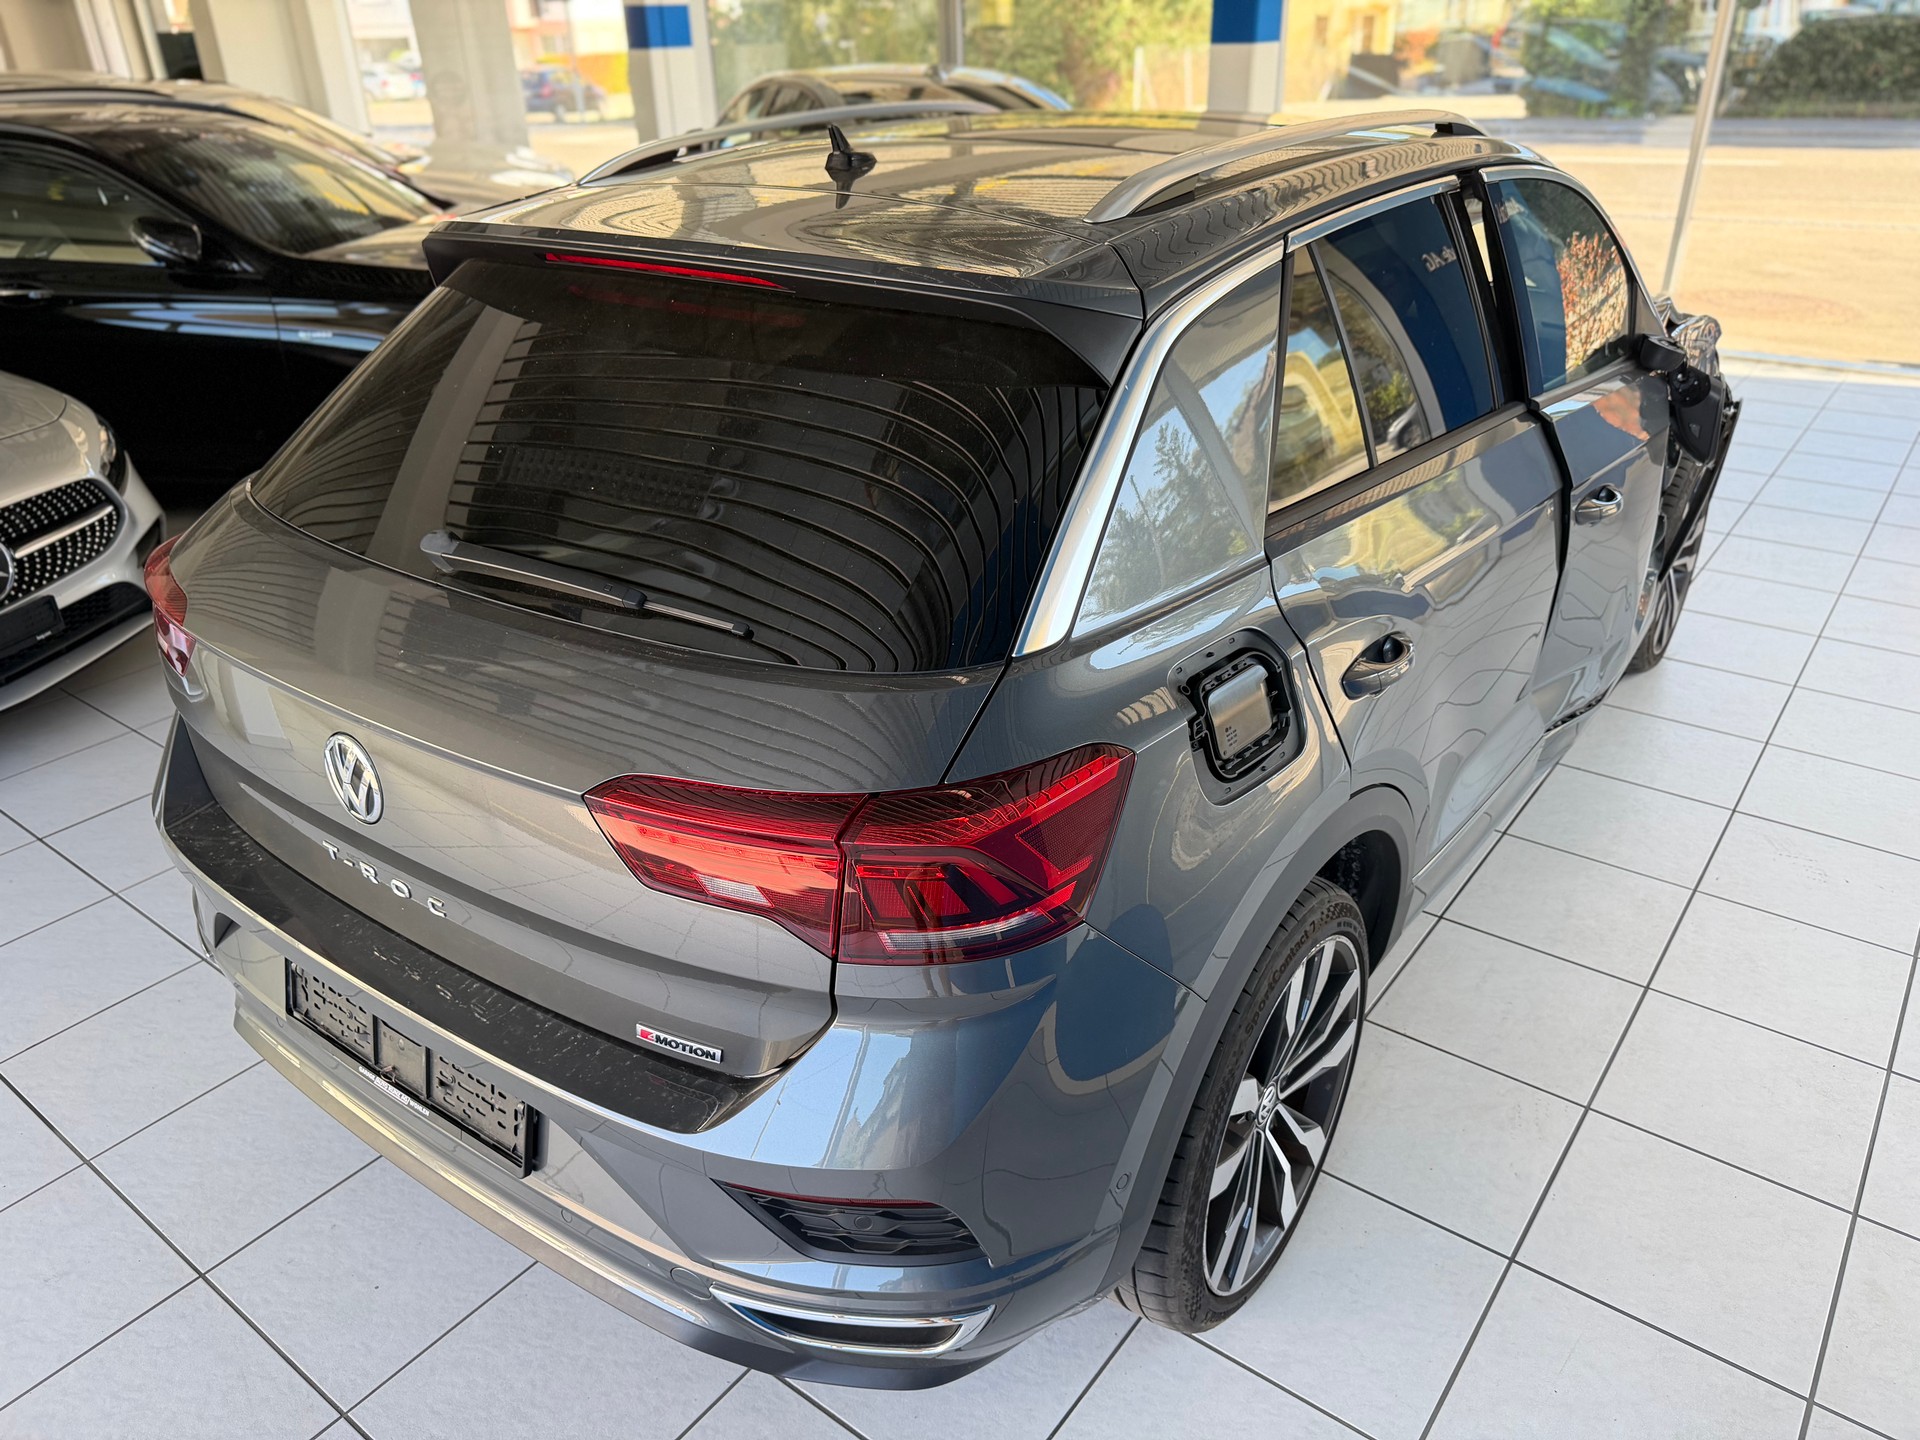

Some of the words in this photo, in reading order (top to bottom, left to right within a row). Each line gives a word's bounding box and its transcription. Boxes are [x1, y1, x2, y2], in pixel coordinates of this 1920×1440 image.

[322, 840, 447, 918] T-ROC
[1244, 930, 1311, 1038] SportContact
[408, 1099, 430, 1116] WOHLEN
